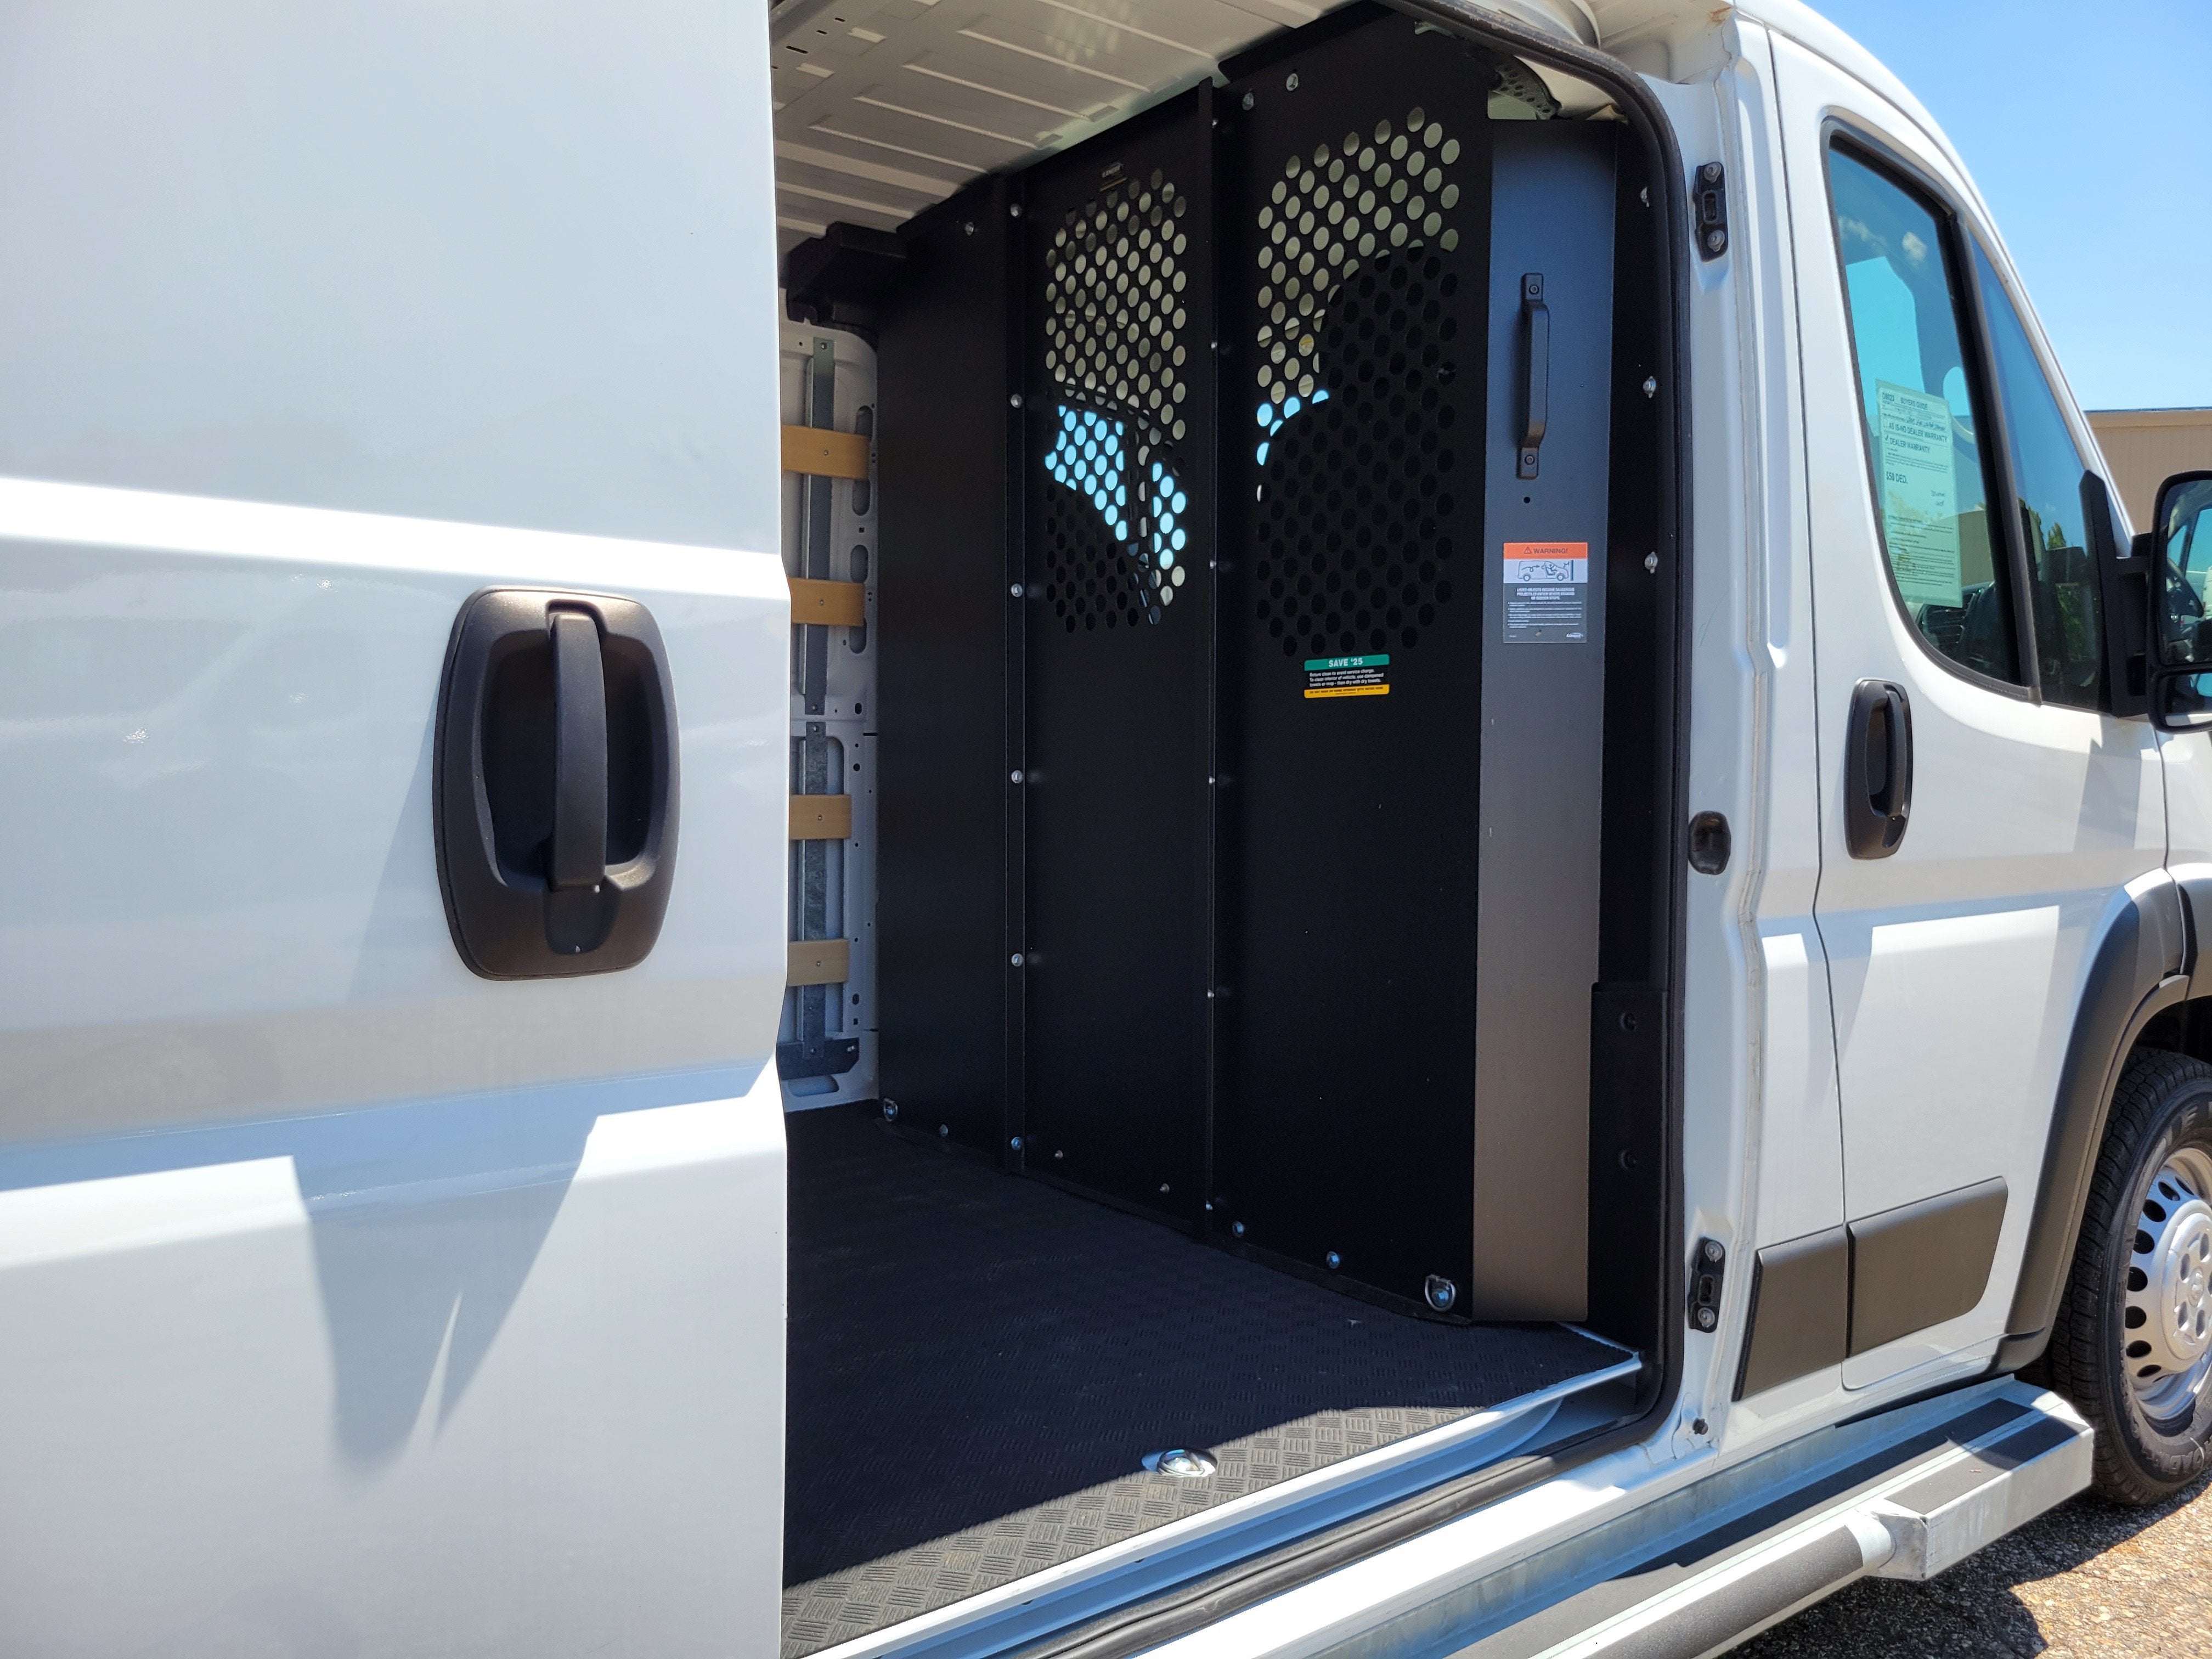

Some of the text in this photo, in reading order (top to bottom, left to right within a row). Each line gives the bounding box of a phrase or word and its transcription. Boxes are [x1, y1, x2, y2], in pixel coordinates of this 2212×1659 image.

[1900, 397, 1916, 407] BUYERS
[1916, 402, 1928, 410] GUIDE
[1907, 427, 1923, 437] DEALER
[1924, 431, 1948, 443] WARRANTY
[1890, 437, 1906, 448] DEALER
[1906, 441, 1931, 453] WARRANTY
[1886, 471, 1908, 484] $50 DED.
[1328, 657, 1363, 668] SAVE $25
